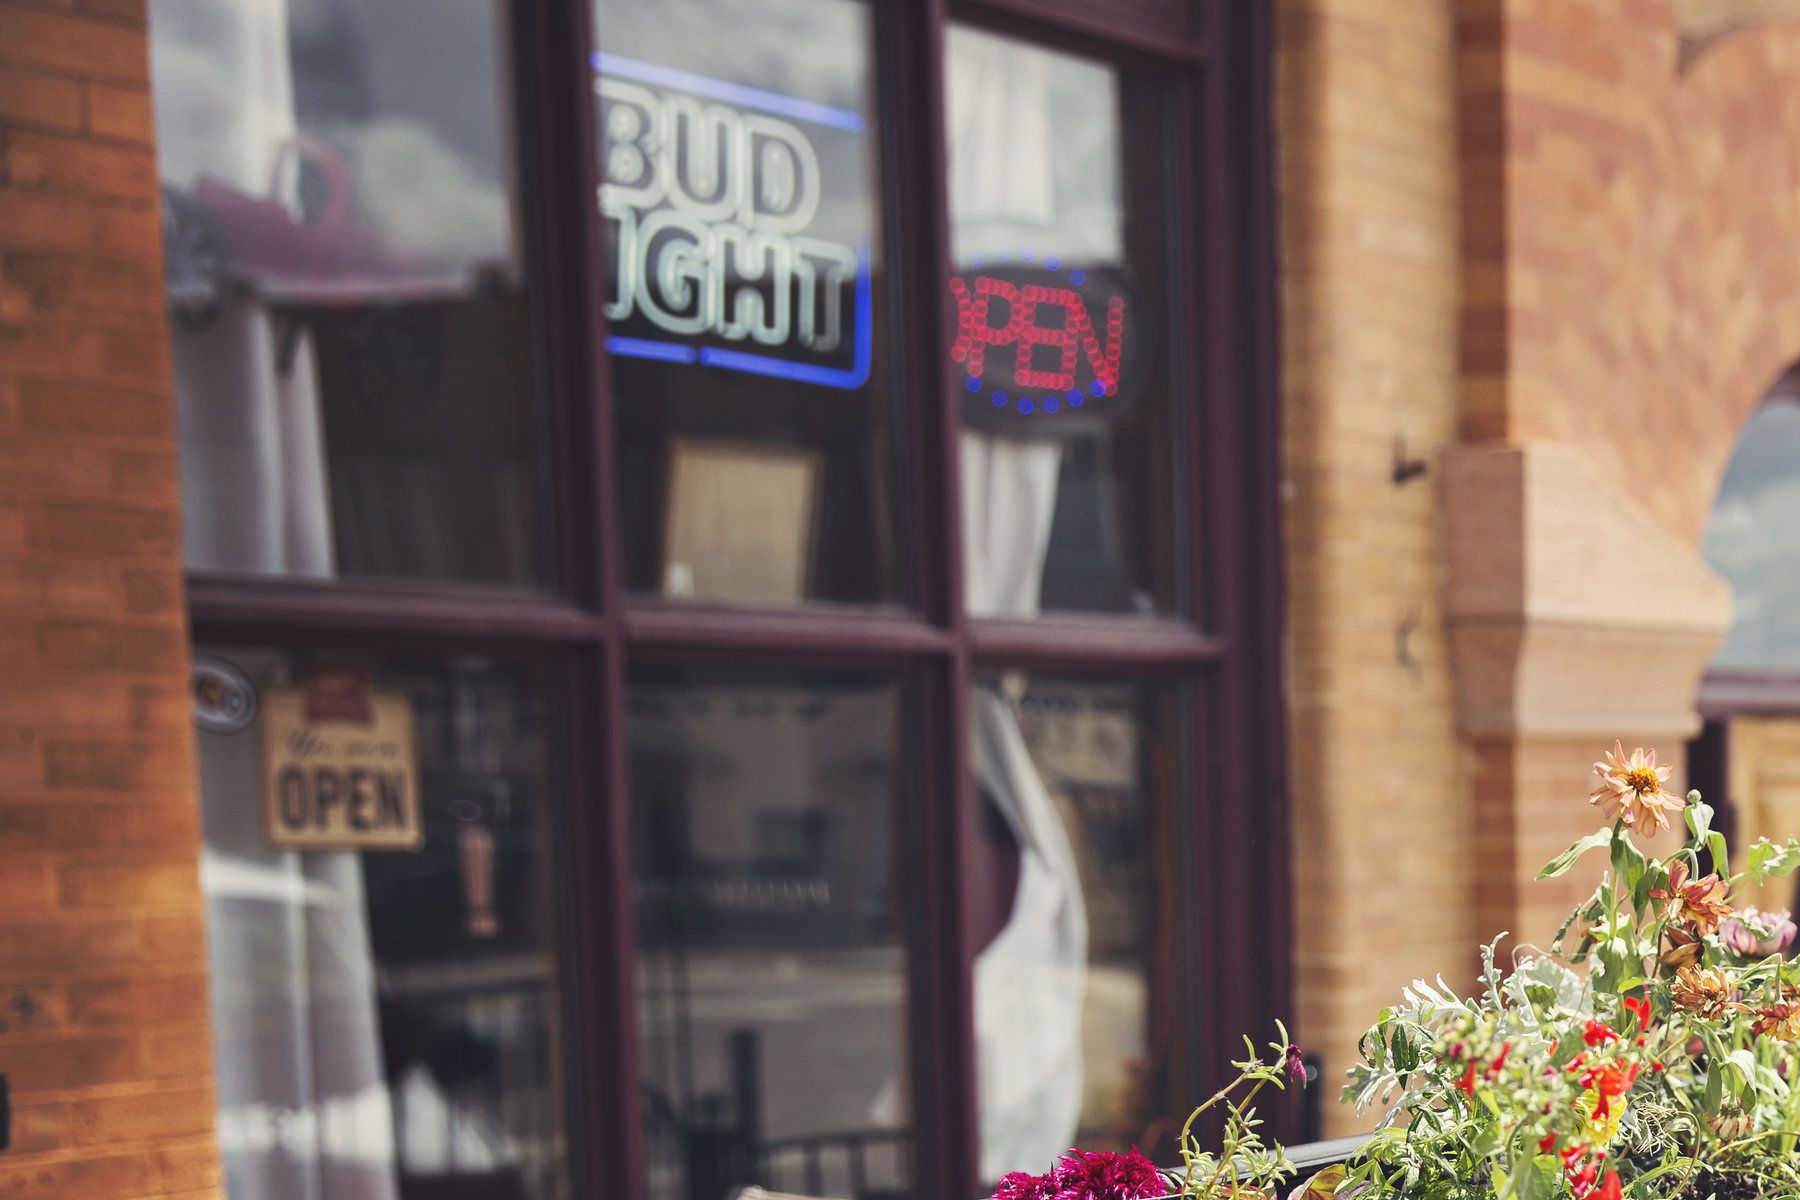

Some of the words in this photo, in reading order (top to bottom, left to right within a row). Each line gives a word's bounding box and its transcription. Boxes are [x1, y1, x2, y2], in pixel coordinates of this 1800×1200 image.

[597, 77, 820, 235] BUD
[602, 203, 857, 350] IGHT
[279, 765, 407, 832] OPEN
